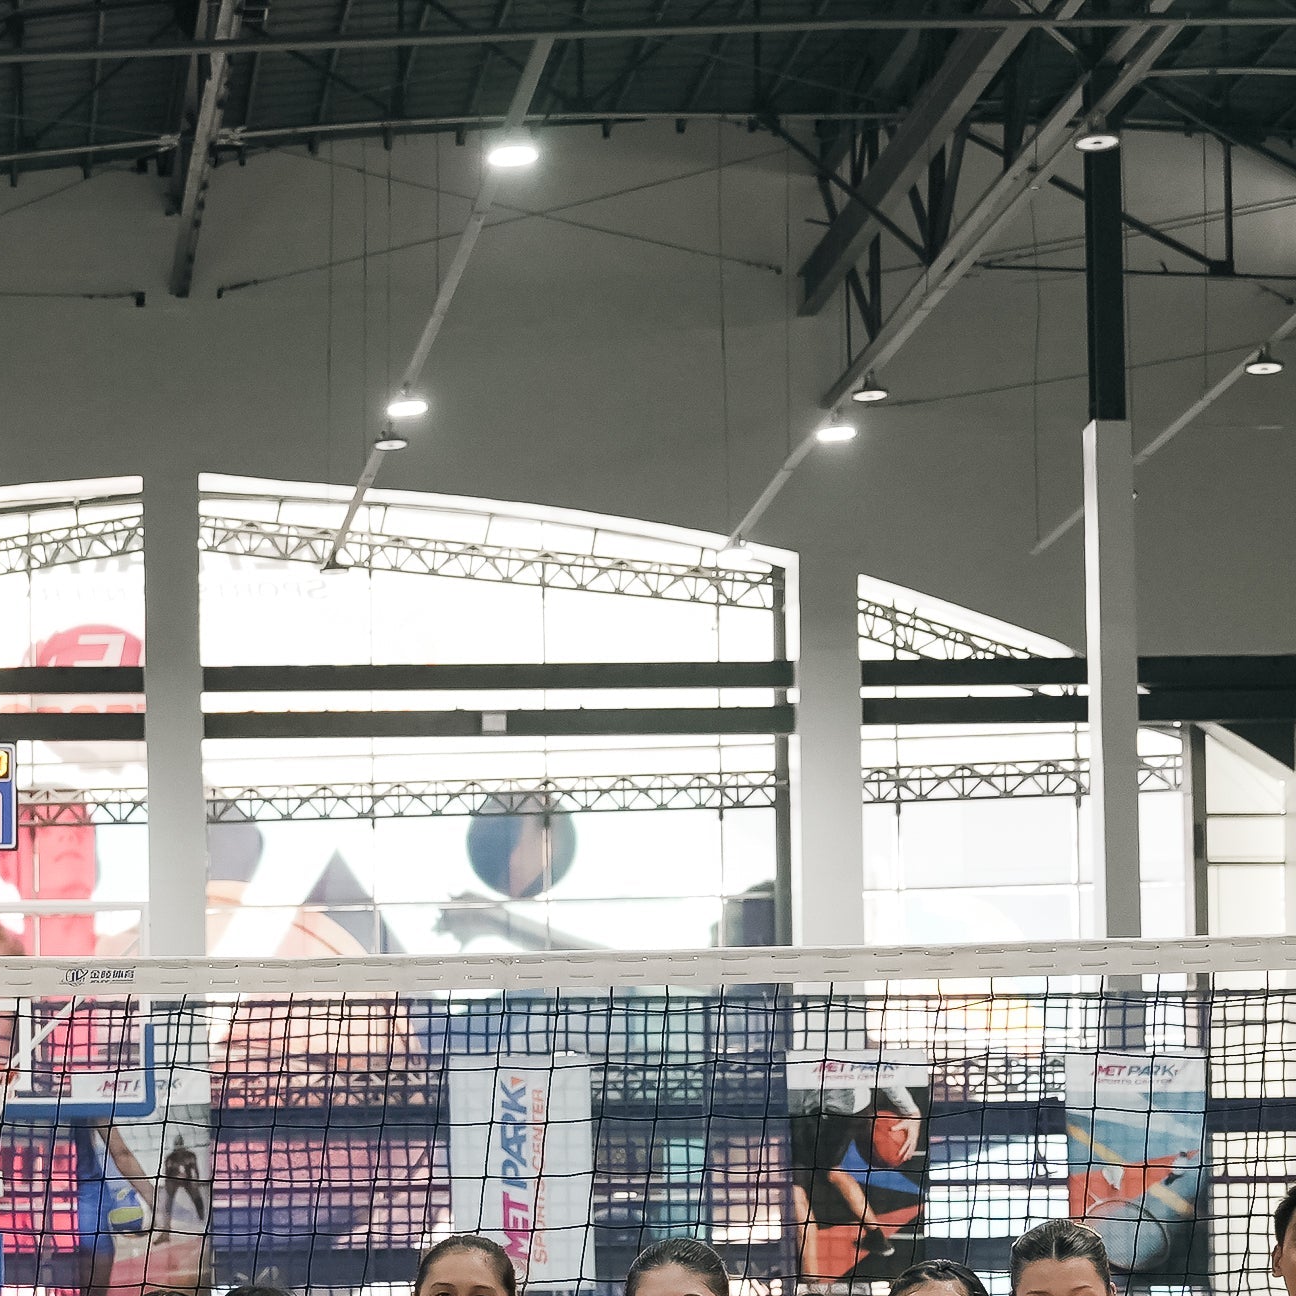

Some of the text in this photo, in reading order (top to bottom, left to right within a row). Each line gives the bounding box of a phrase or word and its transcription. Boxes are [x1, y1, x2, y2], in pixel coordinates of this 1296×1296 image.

[1098, 1065, 1126, 1076] MET
[500, 1080, 529, 1259] MET PARK
